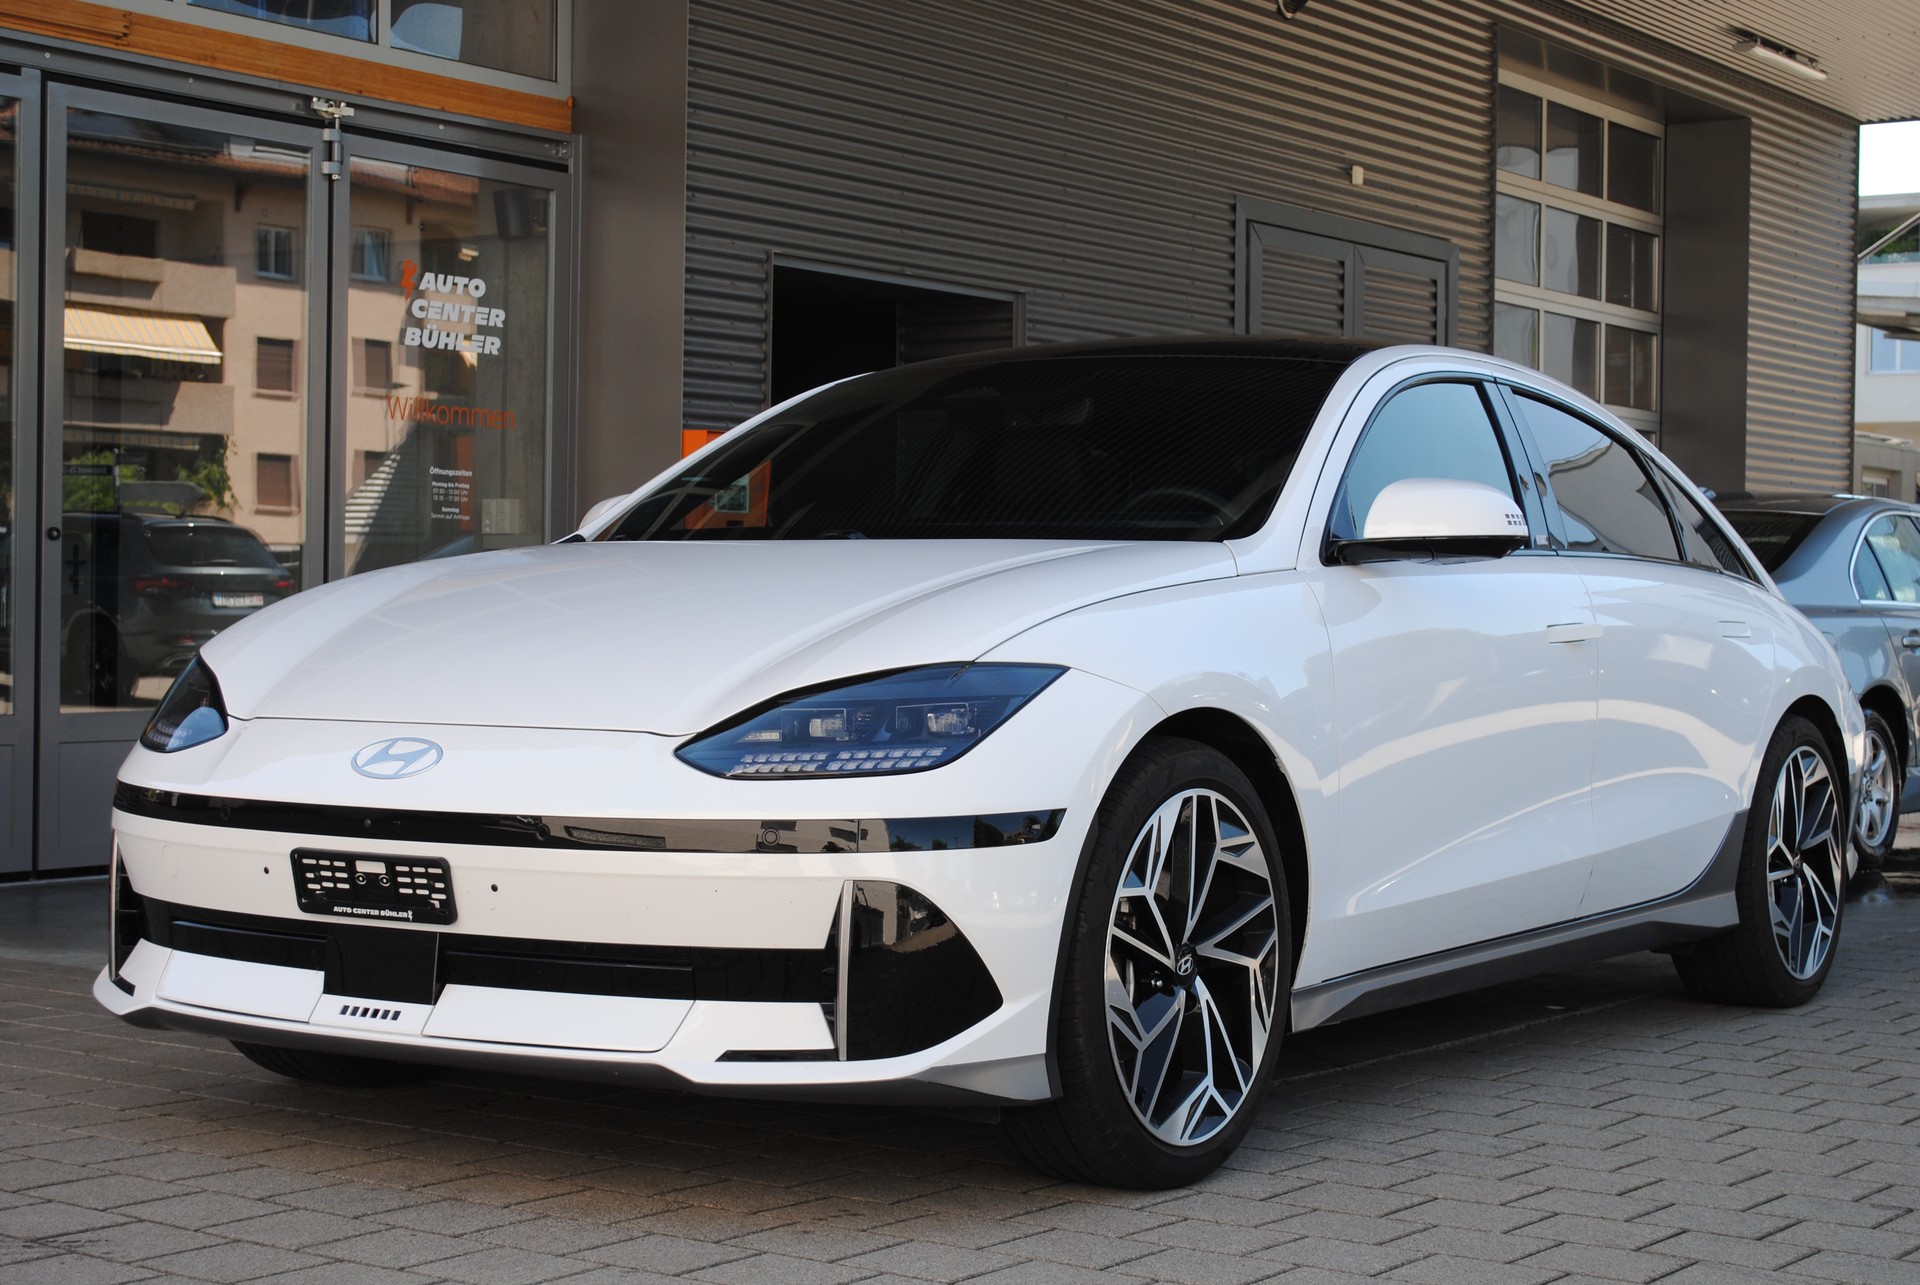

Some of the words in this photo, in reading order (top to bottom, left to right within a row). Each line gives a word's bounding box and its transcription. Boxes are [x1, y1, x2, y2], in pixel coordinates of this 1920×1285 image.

[419, 272, 487, 298] AUTO
[411, 299, 506, 328] CENTER
[404, 324, 501, 355] BÜHLER
[387, 396, 515, 430] Willkommen
[429, 466, 473, 477] Öffnungszeiten
[380, 910, 408, 918] BÜHLER
